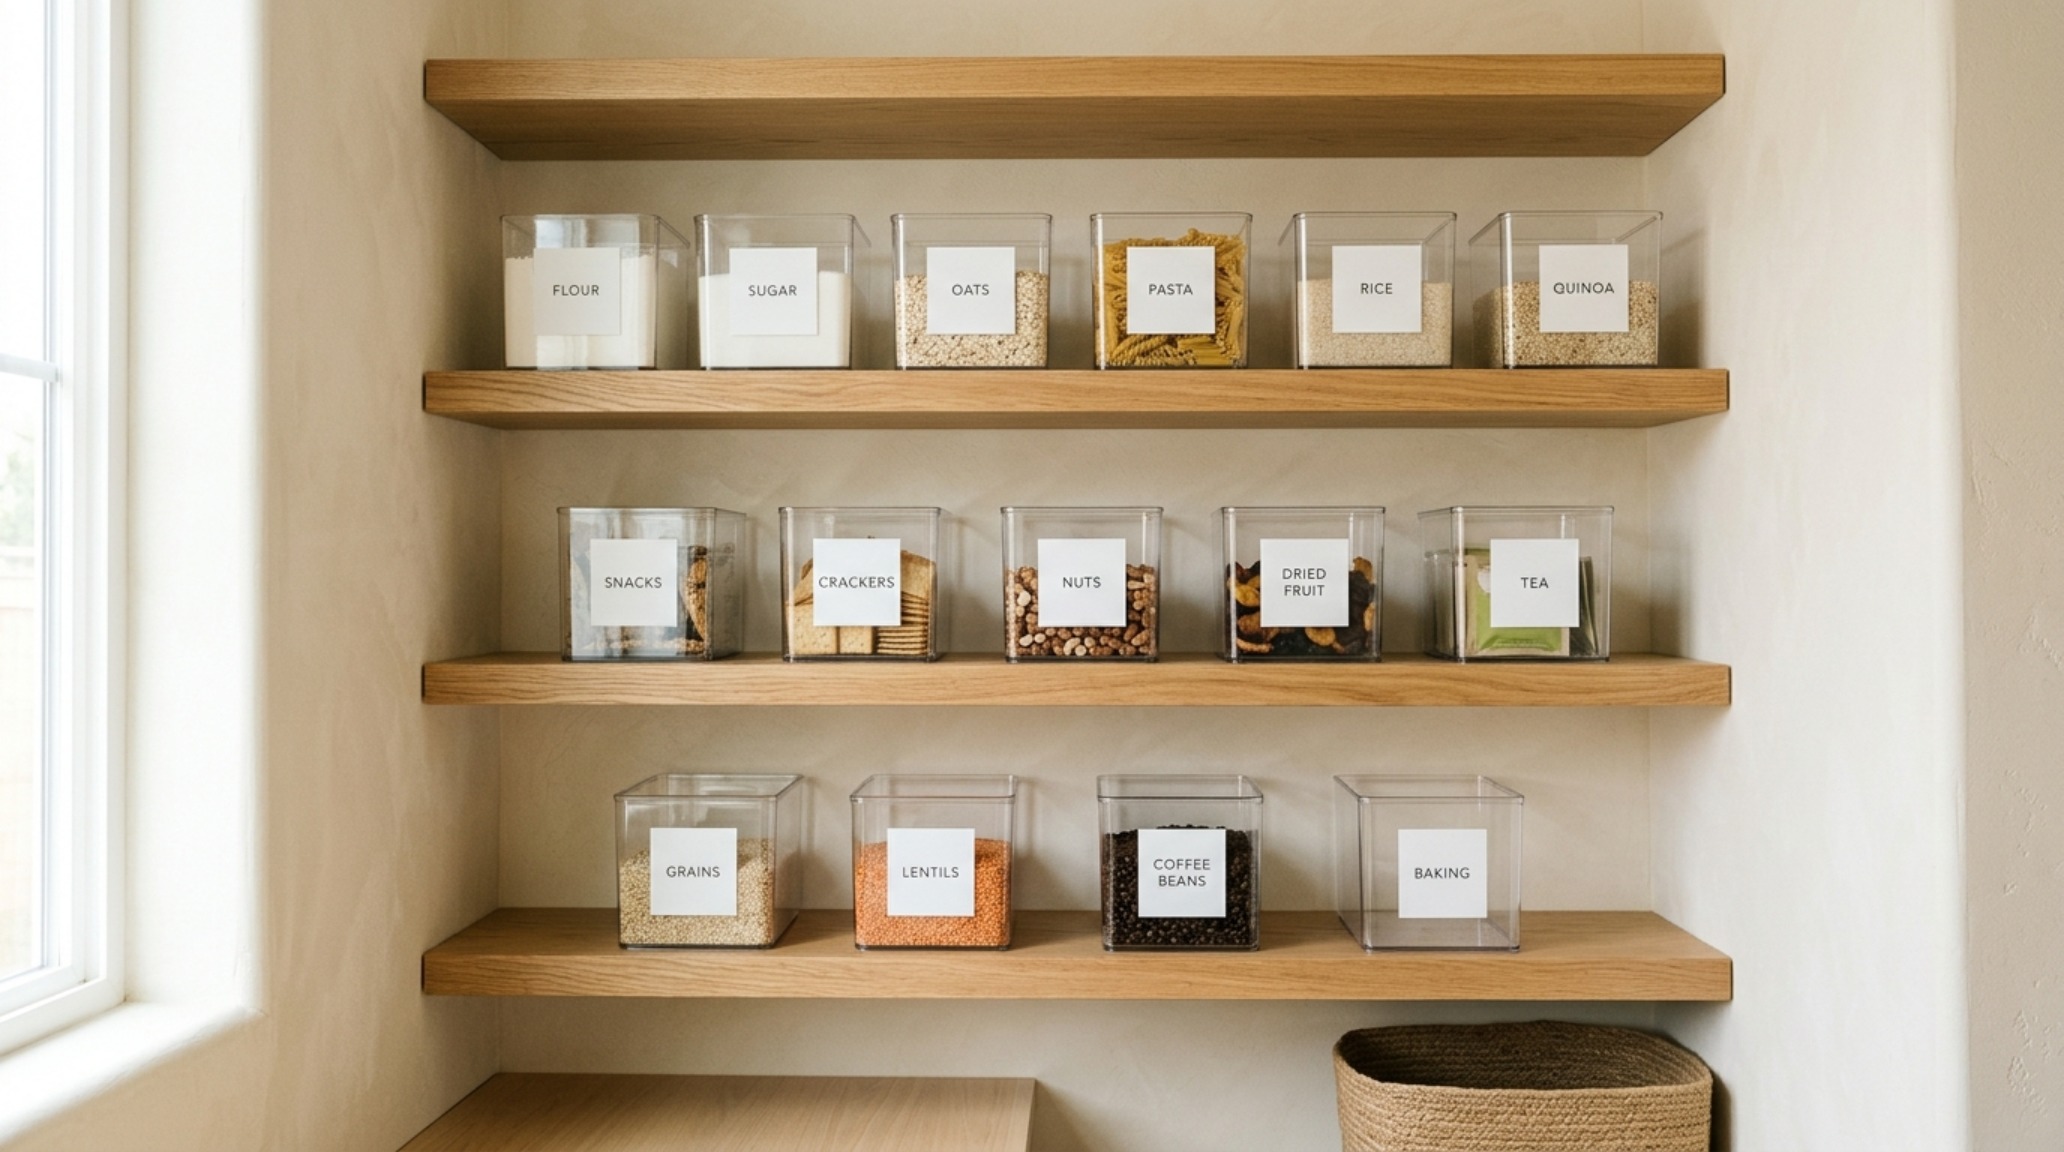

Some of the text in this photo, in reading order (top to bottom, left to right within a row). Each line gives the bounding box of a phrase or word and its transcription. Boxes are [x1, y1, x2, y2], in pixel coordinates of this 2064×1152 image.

[552, 284, 600, 297] FLOUR
[748, 284, 798, 297] SUGAR
[951, 283, 990, 297] OATS
[1148, 282, 1194, 296] PASTA
[1360, 282, 1393, 295] RICE
[1553, 281, 1615, 295] QUINOA
[1282, 567, 1327, 580] DRIED
[604, 576, 663, 589] SNACKS
[818, 575, 895, 589] CRACKERS
[1062, 575, 1102, 589] NUTS
[1520, 576, 1550, 589] TEA
[1283, 584, 1325, 597] FRUIT
[1152, 858, 1211, 871] COFFEE
[665, 865, 721, 879] GRAINS
[902, 866, 960, 879] LENTILS
[1414, 866, 1471, 880] BAKING
[1158, 874, 1207, 888] BEANS
